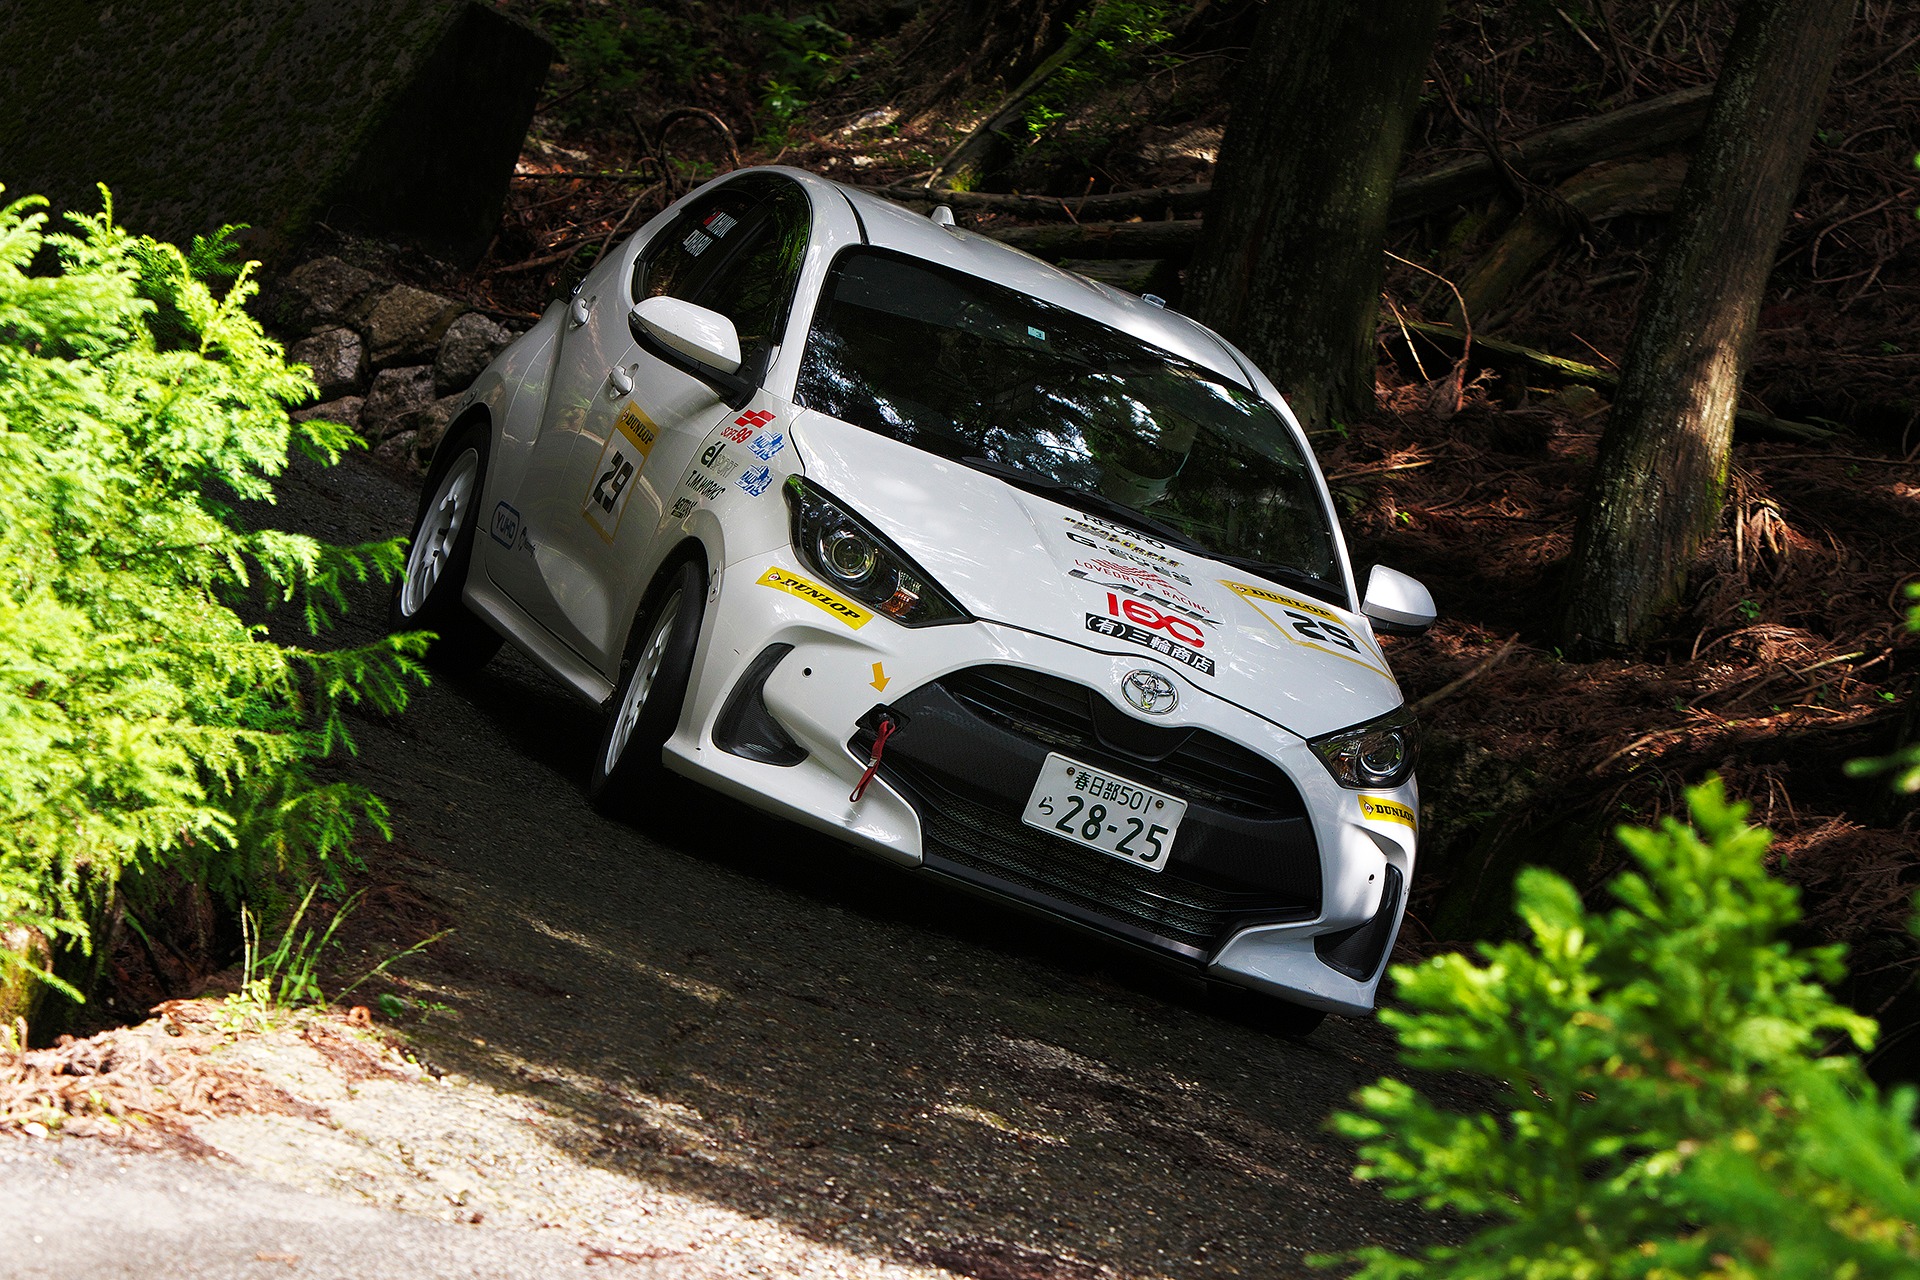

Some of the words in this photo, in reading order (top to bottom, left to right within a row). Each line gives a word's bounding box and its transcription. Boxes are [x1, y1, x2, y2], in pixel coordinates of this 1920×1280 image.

[625, 413, 655, 445] DUNLOP
[592, 450, 634, 514] 29
[780, 578, 861, 619] DUNLOP
[1074, 559, 1156, 591] LOVEDRIVE
[1162, 589, 1210, 614] RACING
[1251, 588, 1331, 617] DUNLOP
[1038, 796, 1054, 815] ら
[1055, 795, 1169, 862] 28-25
